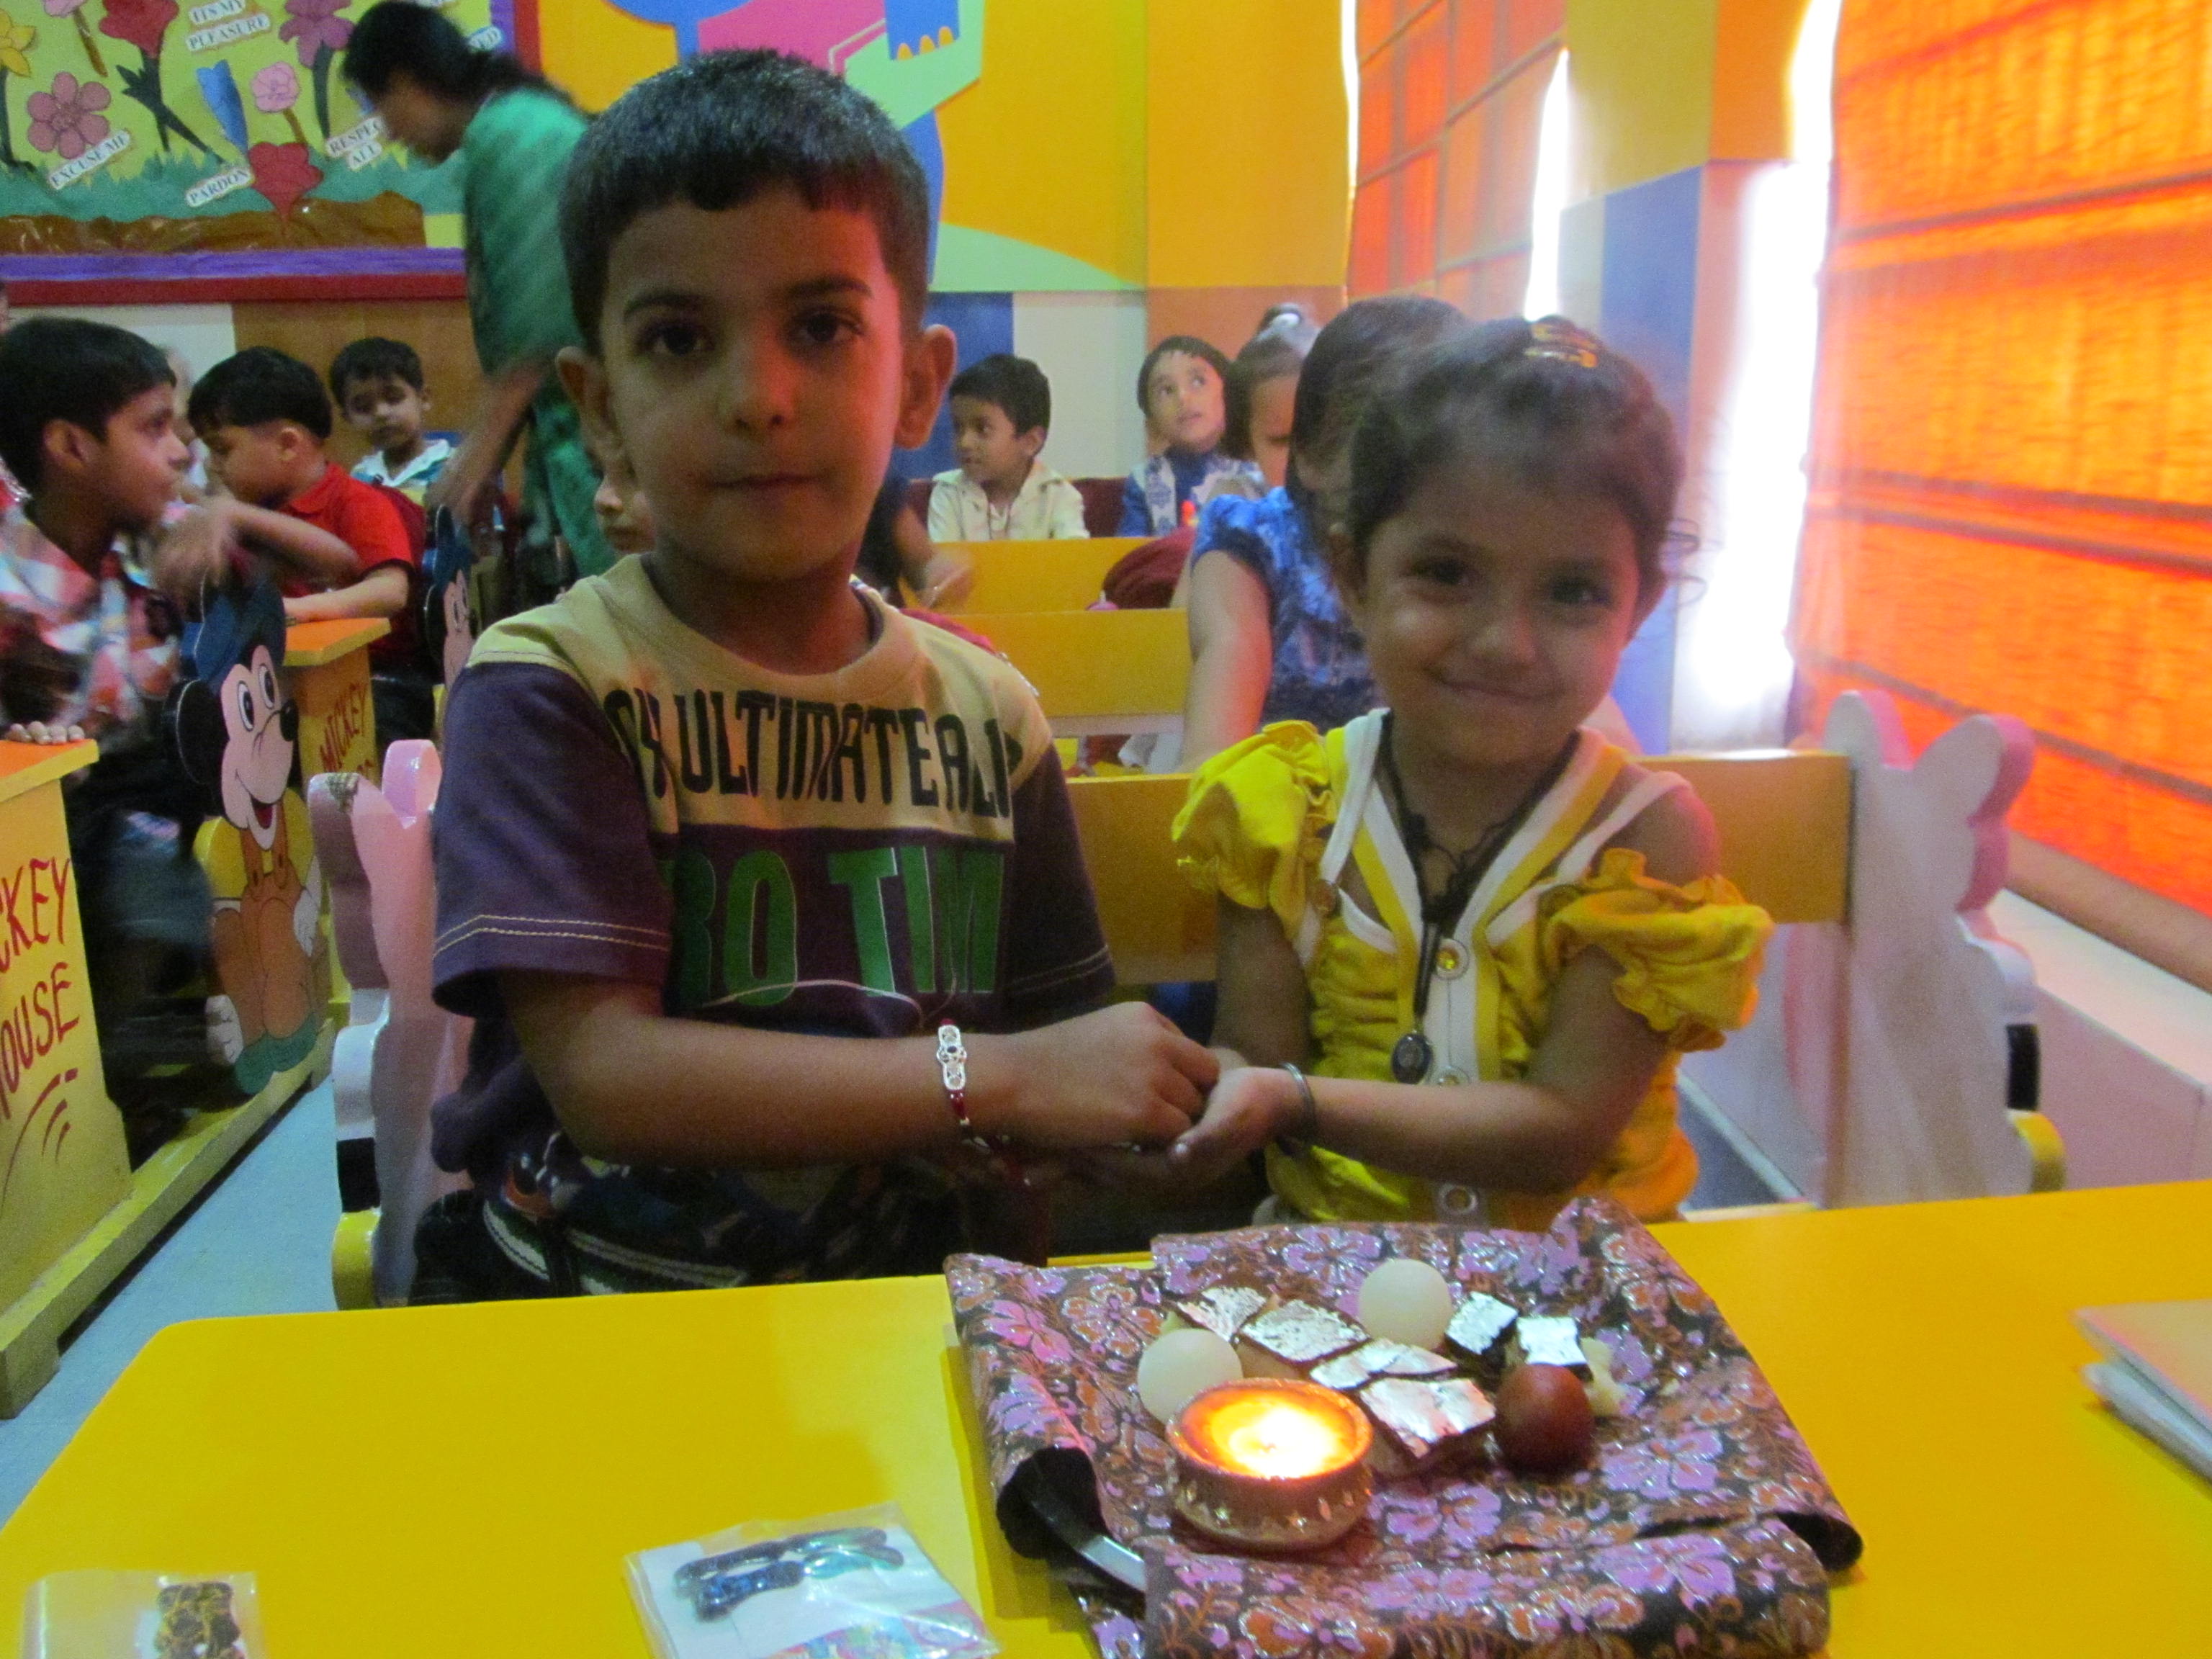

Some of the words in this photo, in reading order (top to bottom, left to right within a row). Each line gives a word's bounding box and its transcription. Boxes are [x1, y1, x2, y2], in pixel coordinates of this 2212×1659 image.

[189, 14, 266, 50] PLEASURE
[189, 169, 248, 204] PARDON
[0, 961, 81, 1121] OUSE
